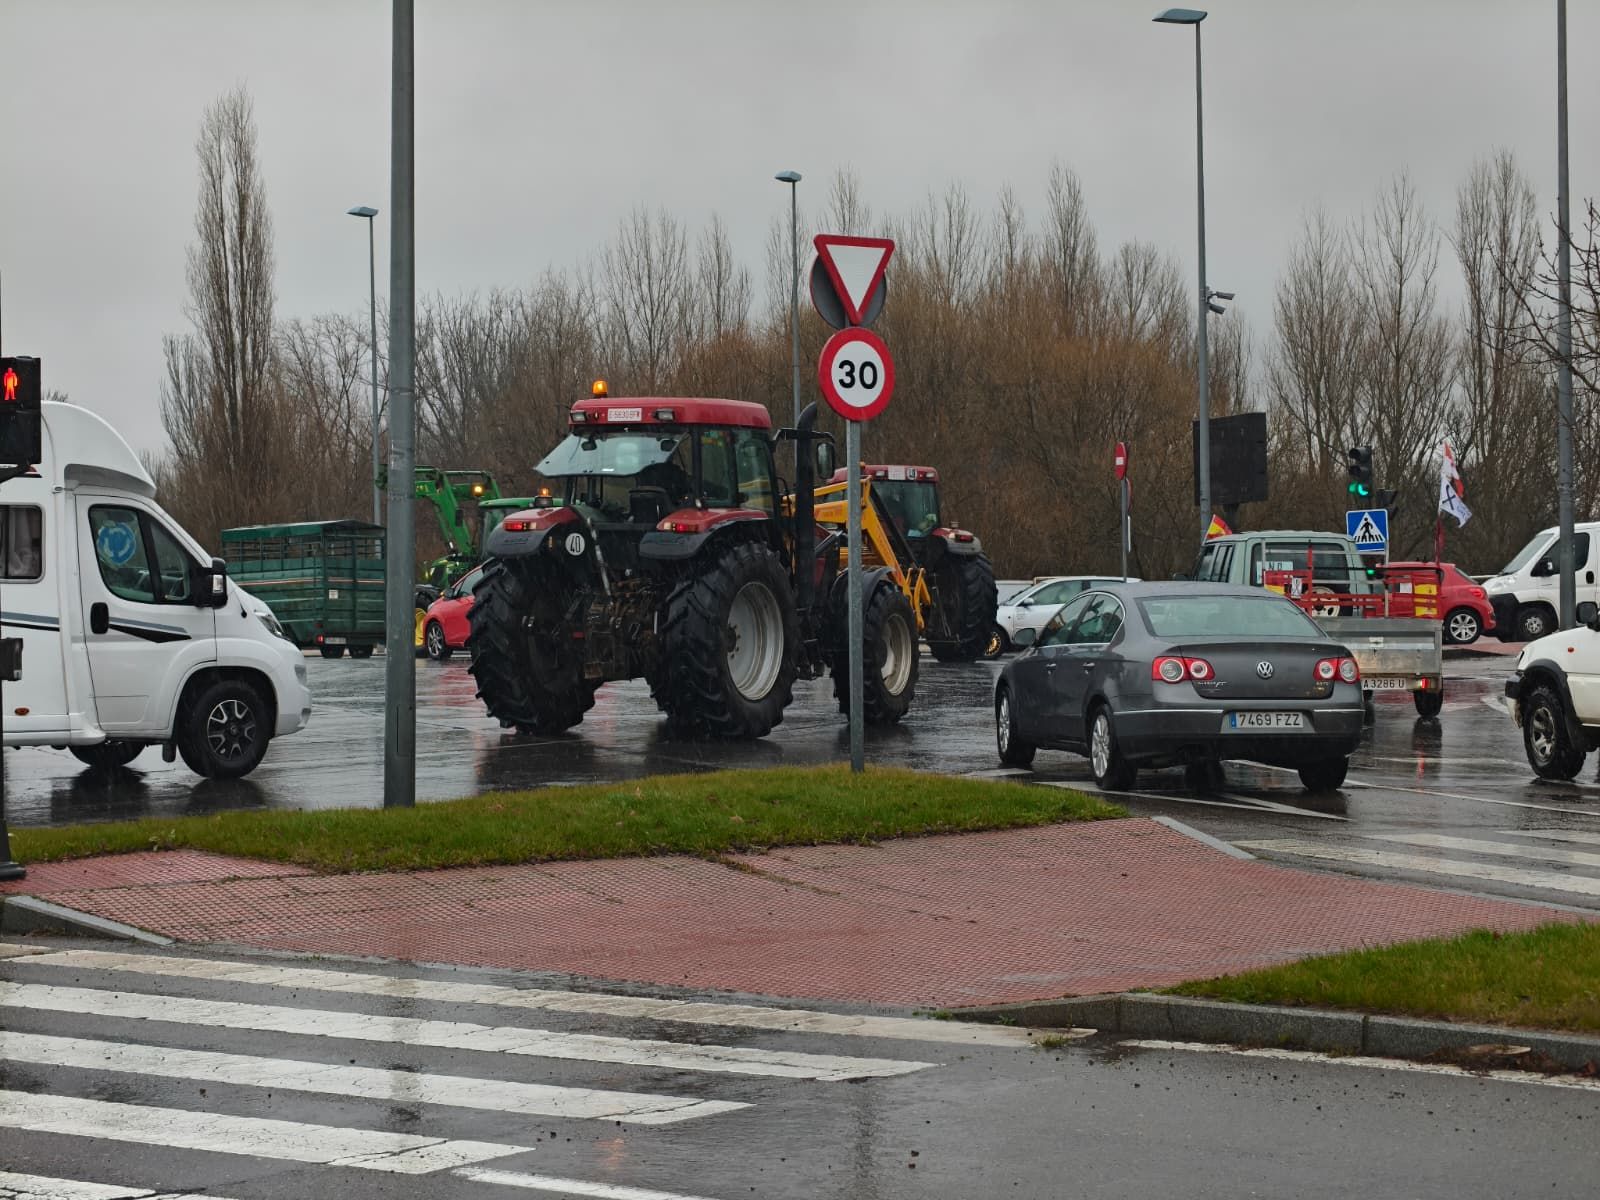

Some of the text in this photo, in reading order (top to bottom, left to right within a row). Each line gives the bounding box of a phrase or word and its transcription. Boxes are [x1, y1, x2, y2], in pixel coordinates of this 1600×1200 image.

[838, 359, 878, 390] 30
[570, 535, 581, 553] 40
[1363, 679, 1369, 689] A
[1398, 679, 1405, 689] U
[1239, 713, 1301, 727] 7469 FZZ
